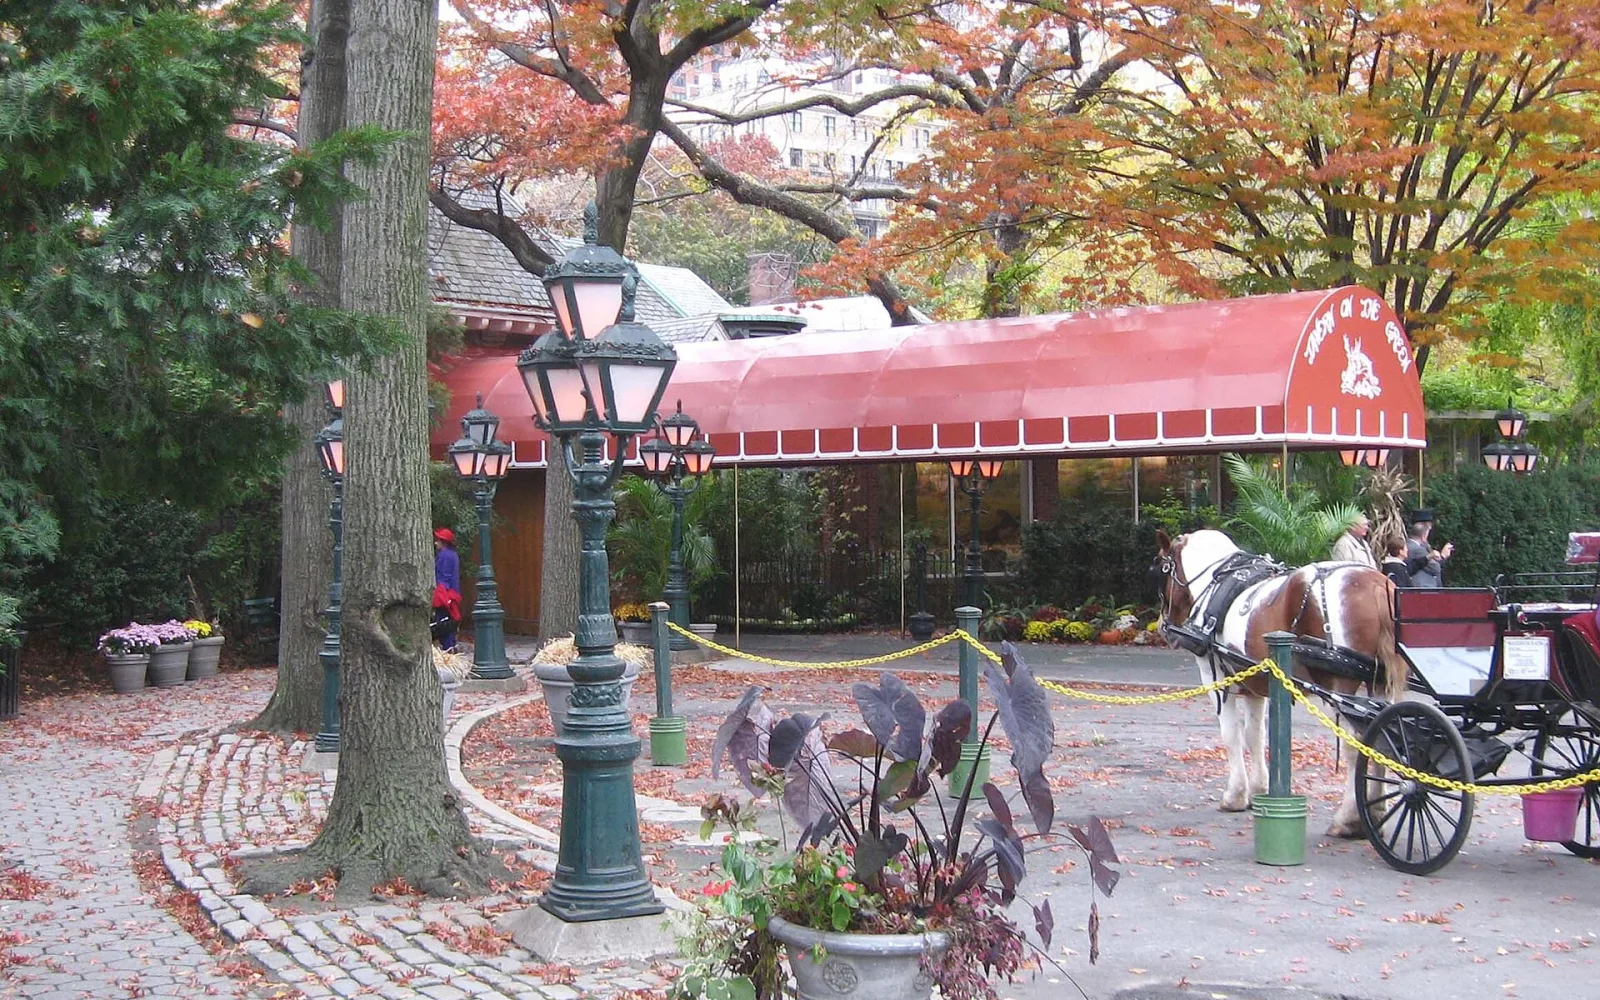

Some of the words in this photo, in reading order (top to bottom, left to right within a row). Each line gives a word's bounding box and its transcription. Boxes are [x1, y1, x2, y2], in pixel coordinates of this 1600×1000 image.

[1303, 303, 1336, 365] TAVERN
[1340, 294, 1354, 318] ON
[1360, 297, 1381, 321] THE
[1385, 321, 1412, 374] GREEN
